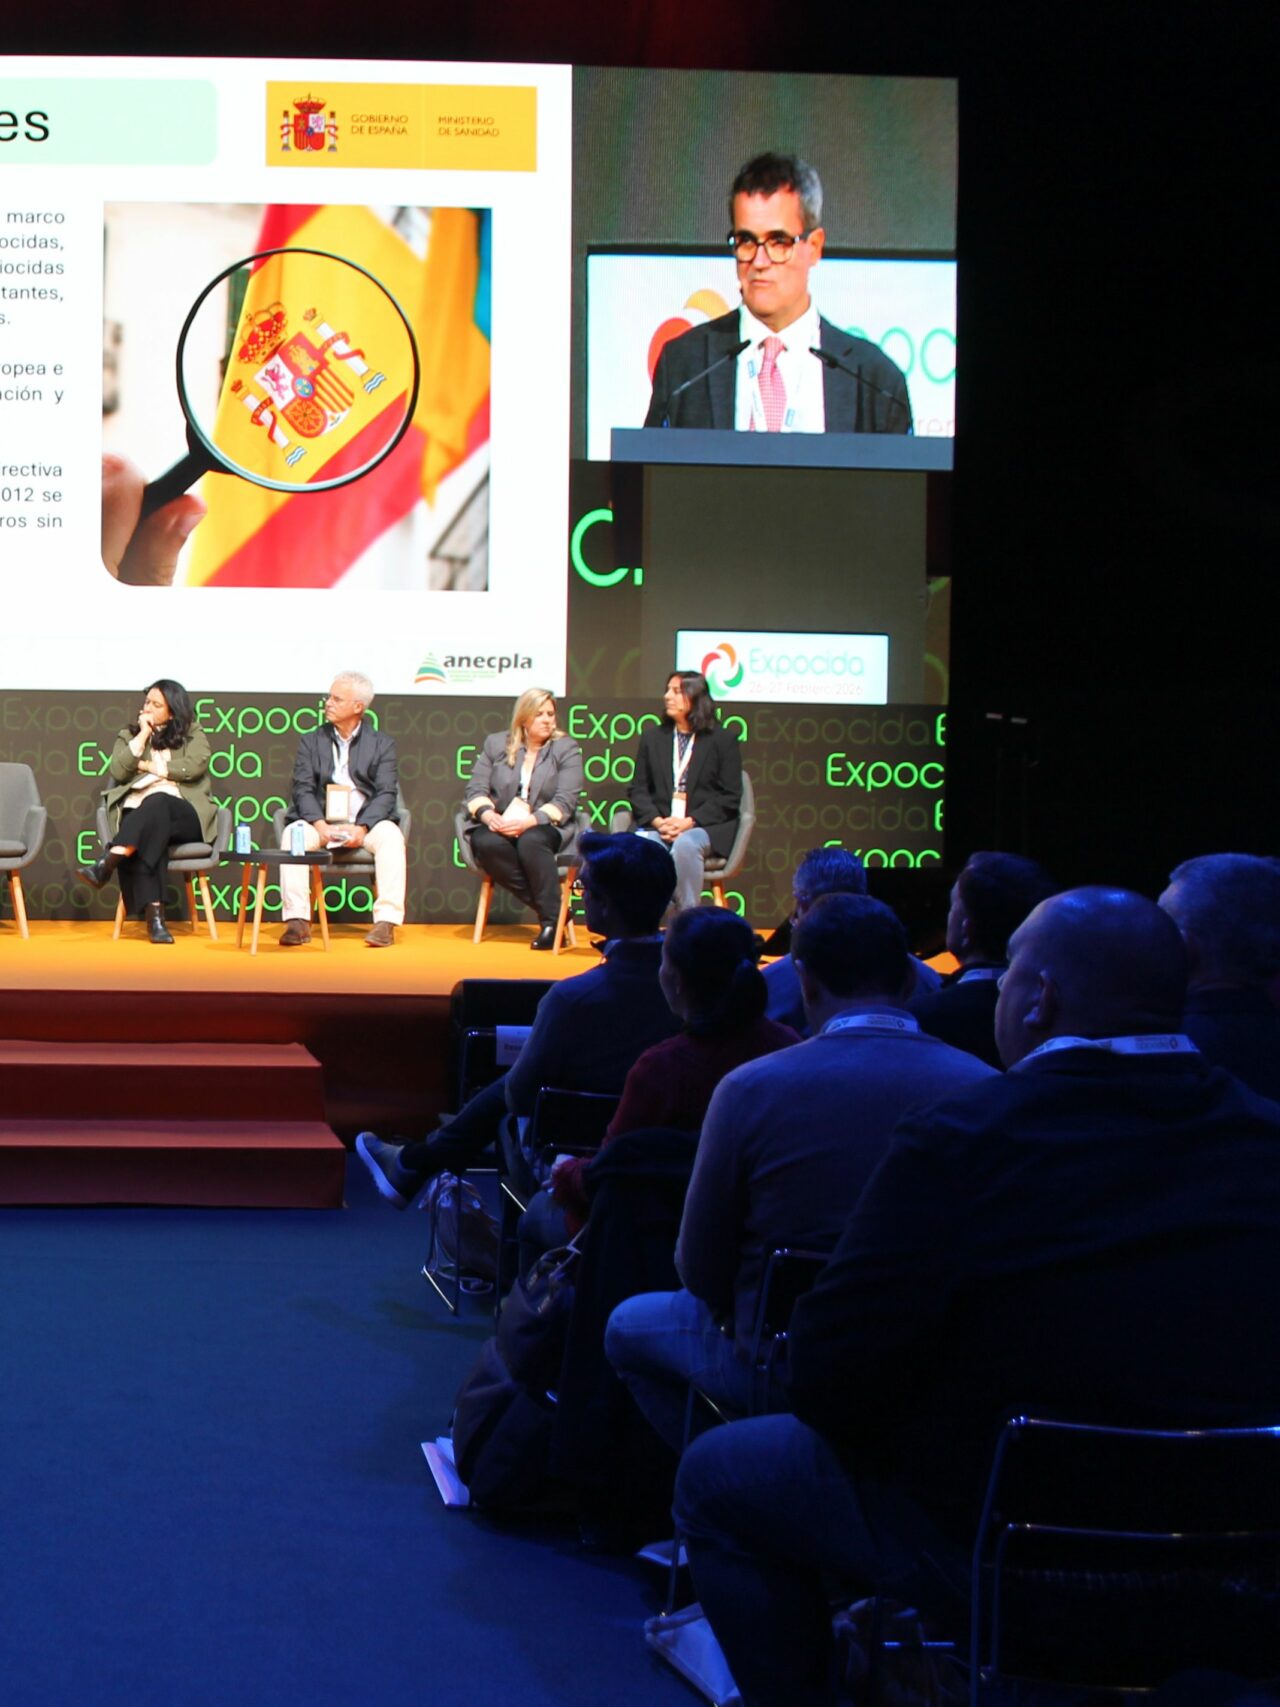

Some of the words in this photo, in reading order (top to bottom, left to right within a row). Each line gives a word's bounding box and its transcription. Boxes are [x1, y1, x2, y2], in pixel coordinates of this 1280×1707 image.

[351, 114, 409, 124] GOBIERNO
[438, 116, 495, 126] MINISTERIO
[351, 125, 364, 135] DE
[368, 124, 408, 135] ESPAÑA
[438, 127, 451, 136] DE
[454, 127, 500, 137] SANIDAD
[6, 212, 65, 224] marco
[53, 364, 64, 376] e
[54, 390, 64, 405] y
[42, 490, 62, 502] se
[37, 516, 62, 528] sin
[443, 653, 533, 674] anecpla
[749, 648, 865, 678] Expocida
[753, 709, 930, 747] Expocida
